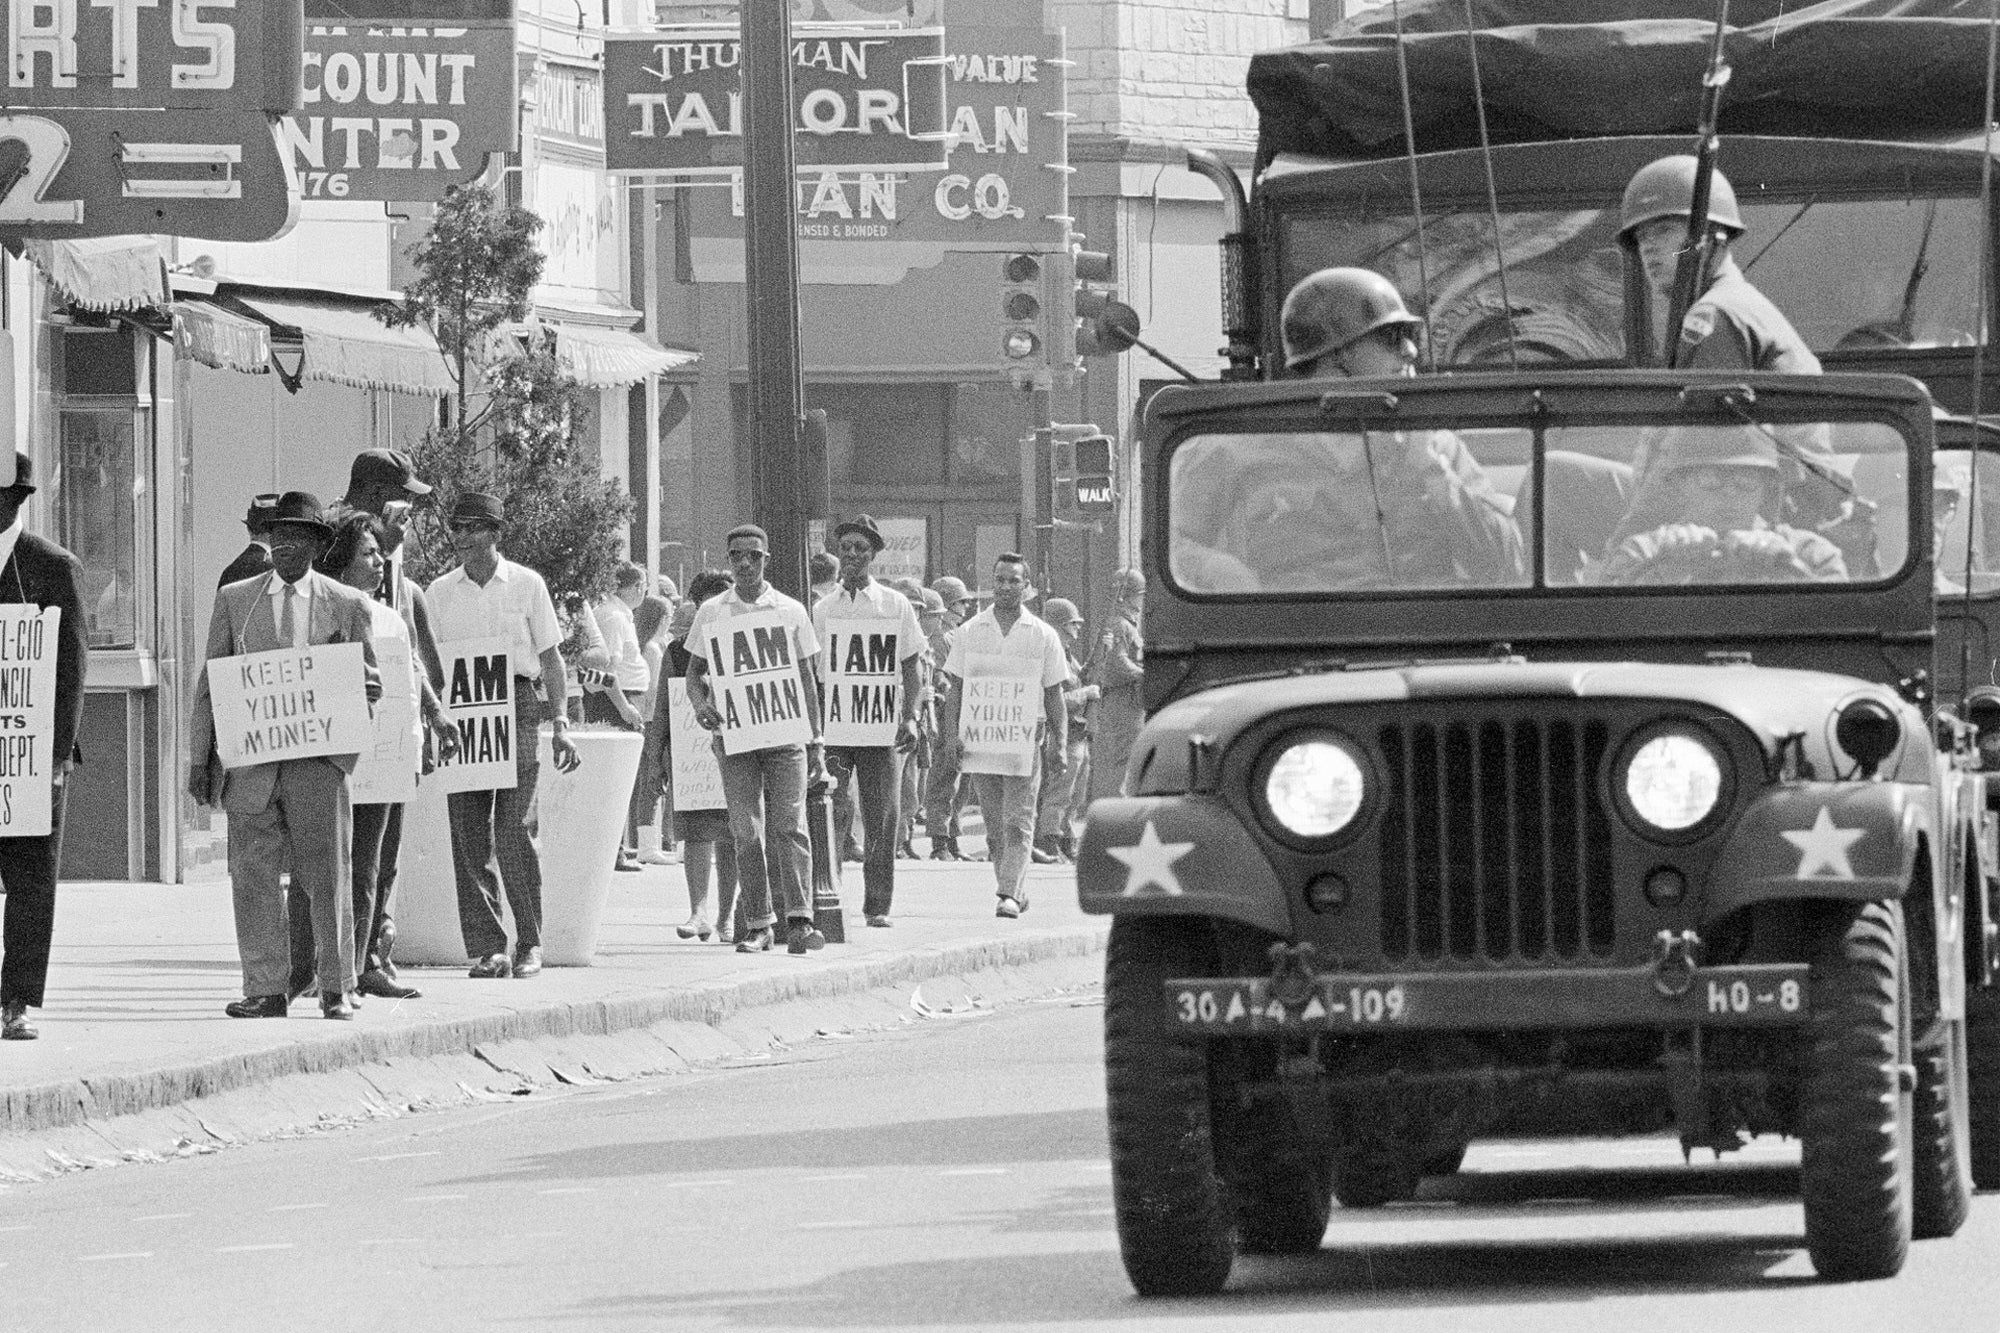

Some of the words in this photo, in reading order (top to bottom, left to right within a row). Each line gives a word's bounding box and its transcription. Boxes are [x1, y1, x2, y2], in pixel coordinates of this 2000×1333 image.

[949, 54, 1039, 84] VALUE
[628, 88, 904, 137] TAIOR
[832, 225, 841, 238] &
[845, 225, 888, 238] BONDED
[1078, 488, 1111, 502] WALK
[0, 619, 43, 661] L-CIO
[710, 636, 725, 676] I
[733, 625, 791, 673] AM
[830, 633, 838, 672] I
[845, 633, 897, 673] AM
[241, 656, 313, 689] KEEP
[450, 654, 508, 705] AM
[970, 681, 1024, 699] KEEP
[246, 689, 316, 721] YOUR
[725, 688, 741, 730] A
[745, 677, 801, 725] MAN
[829, 683, 841, 722] A
[852, 684, 895, 724] MAN
[969, 704, 1022, 722] YOUR
[245, 717, 332, 755] MONEY
[457, 714, 510, 765] MAN
[965, 725, 1032, 742] MONEY
